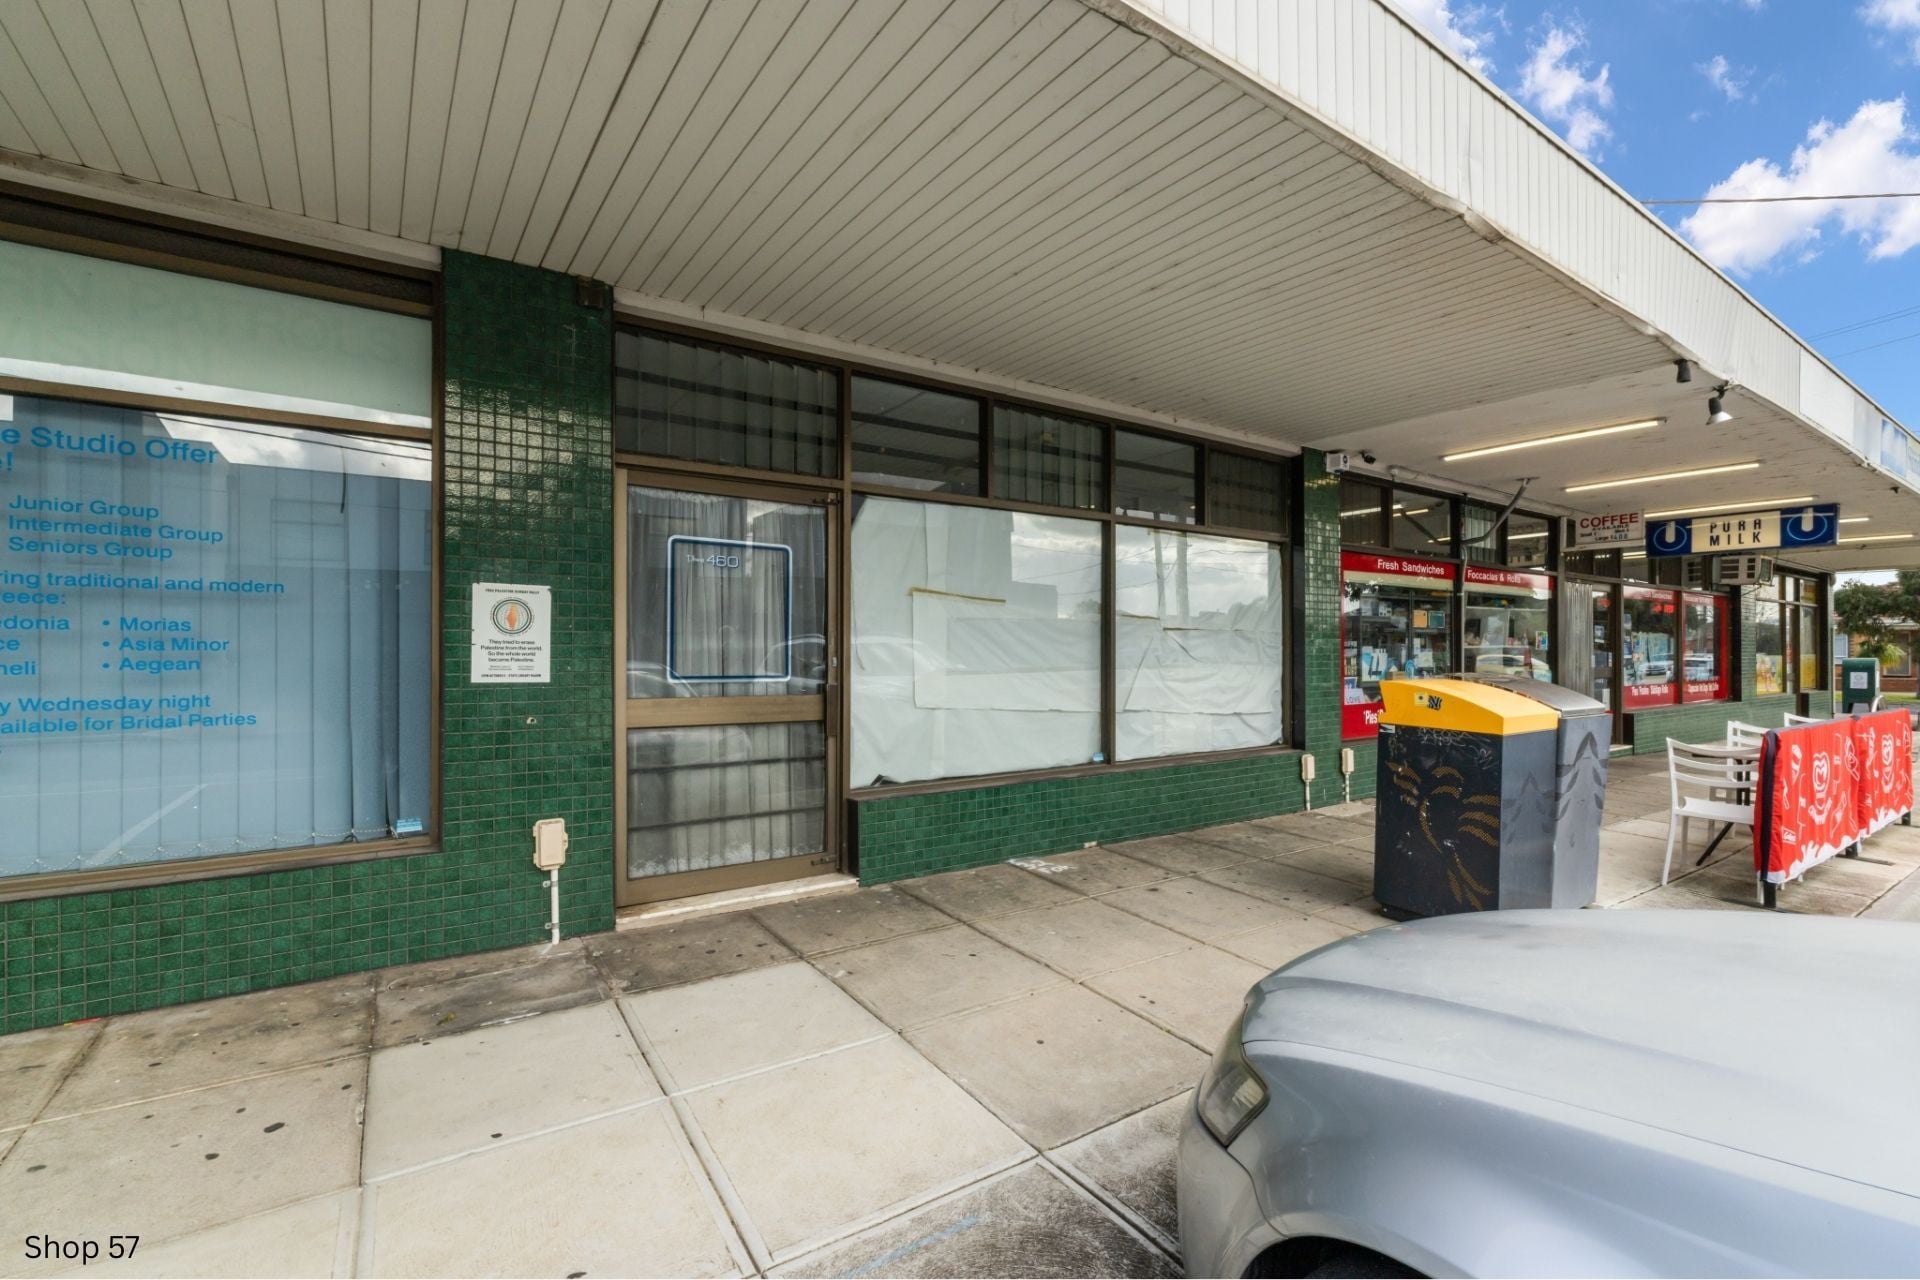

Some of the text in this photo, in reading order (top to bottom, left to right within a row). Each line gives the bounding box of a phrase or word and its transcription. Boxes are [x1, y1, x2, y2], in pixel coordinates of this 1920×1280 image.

[31, 426, 137, 457] Studio
[145, 438, 218, 464] Offer
[8, 494, 159, 521] Junior Group
[1580, 512, 1639, 529] COFFEE
[1710, 519, 1762, 534] PURA
[9, 515, 224, 545] Intermediate Group
[1710, 531, 1761, 547] MILK
[9, 536, 173, 560] Seniors Group
[1377, 558, 1445, 576] Fresh Sandwiches
[47, 572, 159, 590] traditional
[164, 577, 203, 591] and
[209, 580, 285, 594] modern
[1500, 573, 1505, 582] &
[119, 617, 192, 632] Morias
[119, 637, 230, 651] Asia Minor
[119, 657, 200, 674] Aegean
[18, 697, 152, 712] Wednesday
[158, 694, 211, 710] night
[1, 712, 257, 734] ailable for Bridal Parties
